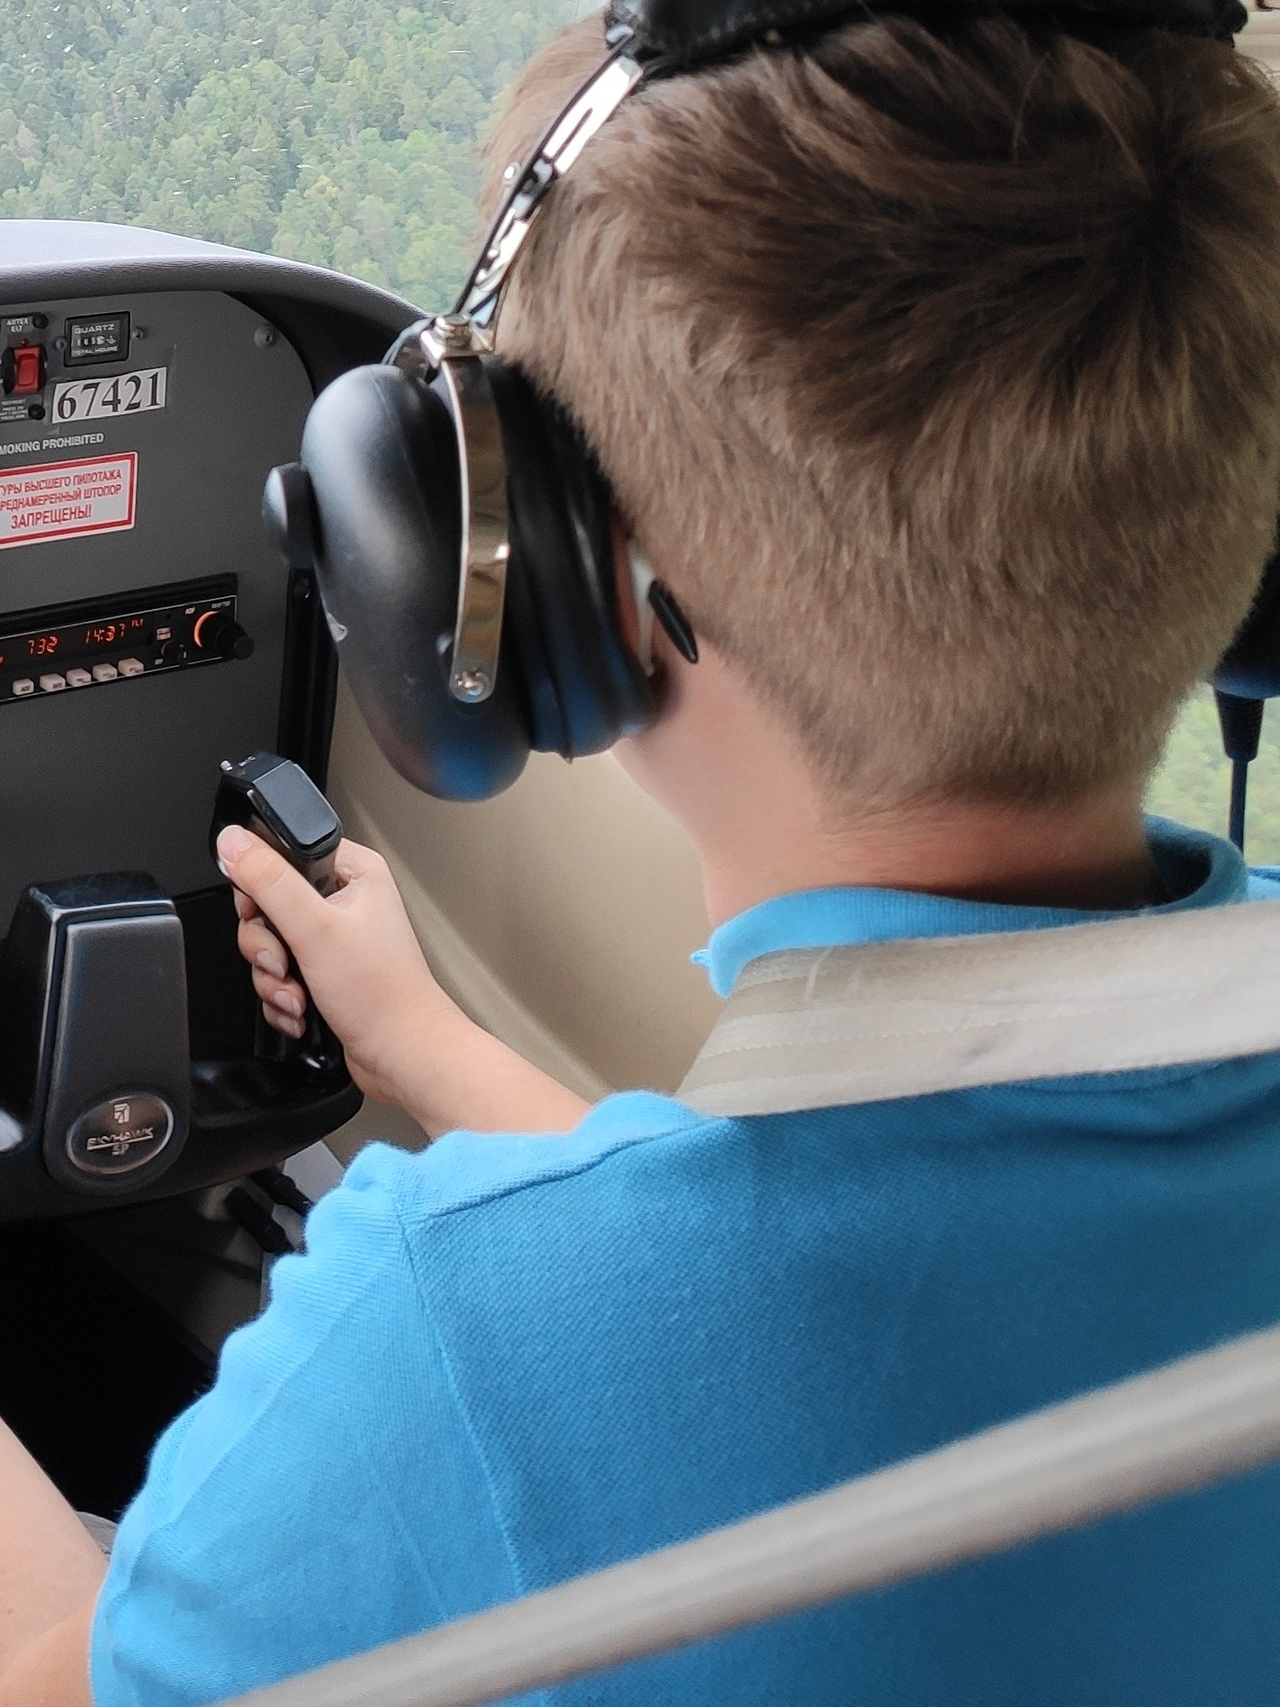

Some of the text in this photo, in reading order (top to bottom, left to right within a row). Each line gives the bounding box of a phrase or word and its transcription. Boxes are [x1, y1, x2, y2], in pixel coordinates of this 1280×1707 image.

[75, 323, 114, 334] QUARTZ
[58, 372, 161, 419] 67421
[42, 433, 104, 450] PROHIBITED
[25, 476, 71, 492] ВЫСШЕГО
[73, 469, 122, 485] ПИЛОТАЖА
[83, 484, 122, 499] ШТОПОР
[11, 505, 92, 529] ЗАПРЕЩЕНЫ!
[112, 1144, 129, 1155] SP
